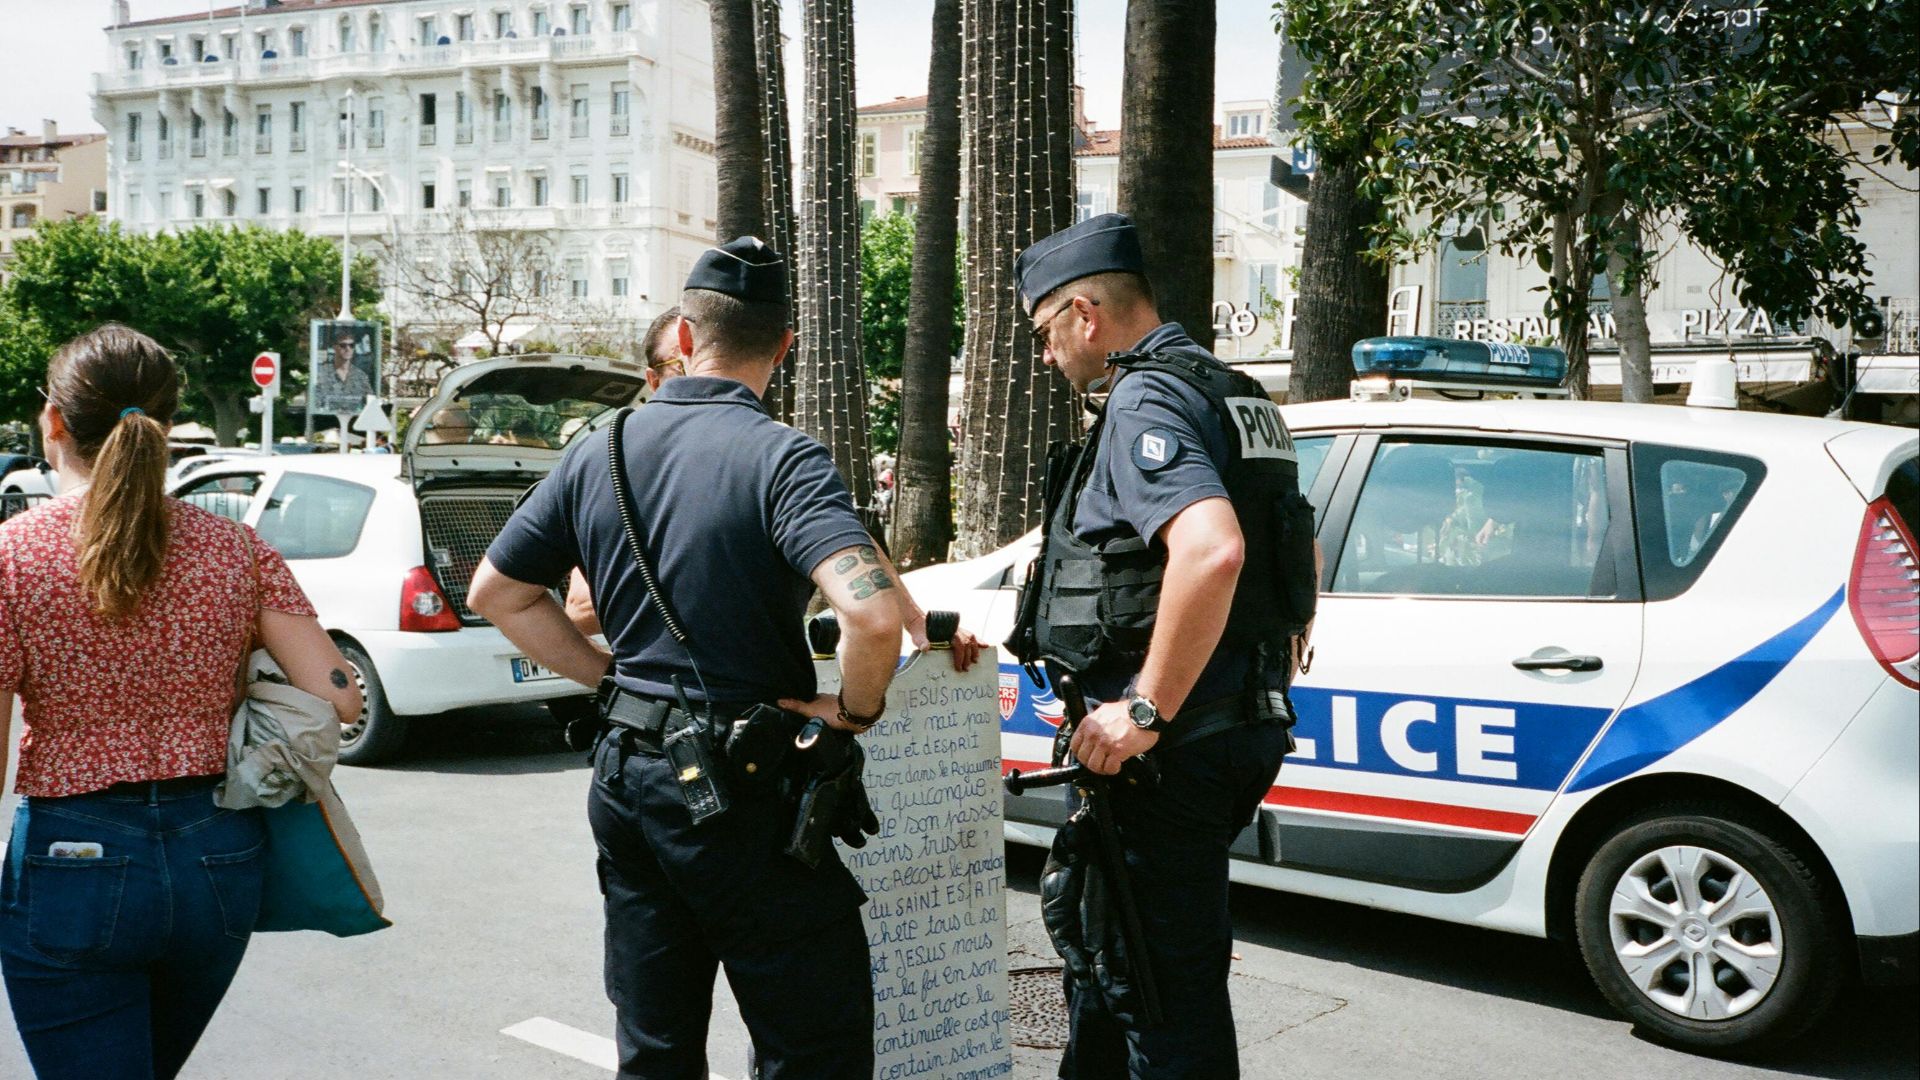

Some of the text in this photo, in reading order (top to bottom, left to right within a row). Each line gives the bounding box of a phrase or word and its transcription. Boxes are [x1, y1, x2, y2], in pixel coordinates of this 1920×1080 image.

[1680, 306, 1774, 337] PIZZA
[1489, 342, 1530, 364] POLICE
[897, 683, 994, 719] JESUS nous
[903, 813, 939, 834] son
[849, 841, 913, 869] moins
[894, 942, 946, 979] JESUS
[951, 932, 992, 954] nous
[967, 958, 998, 979] son
